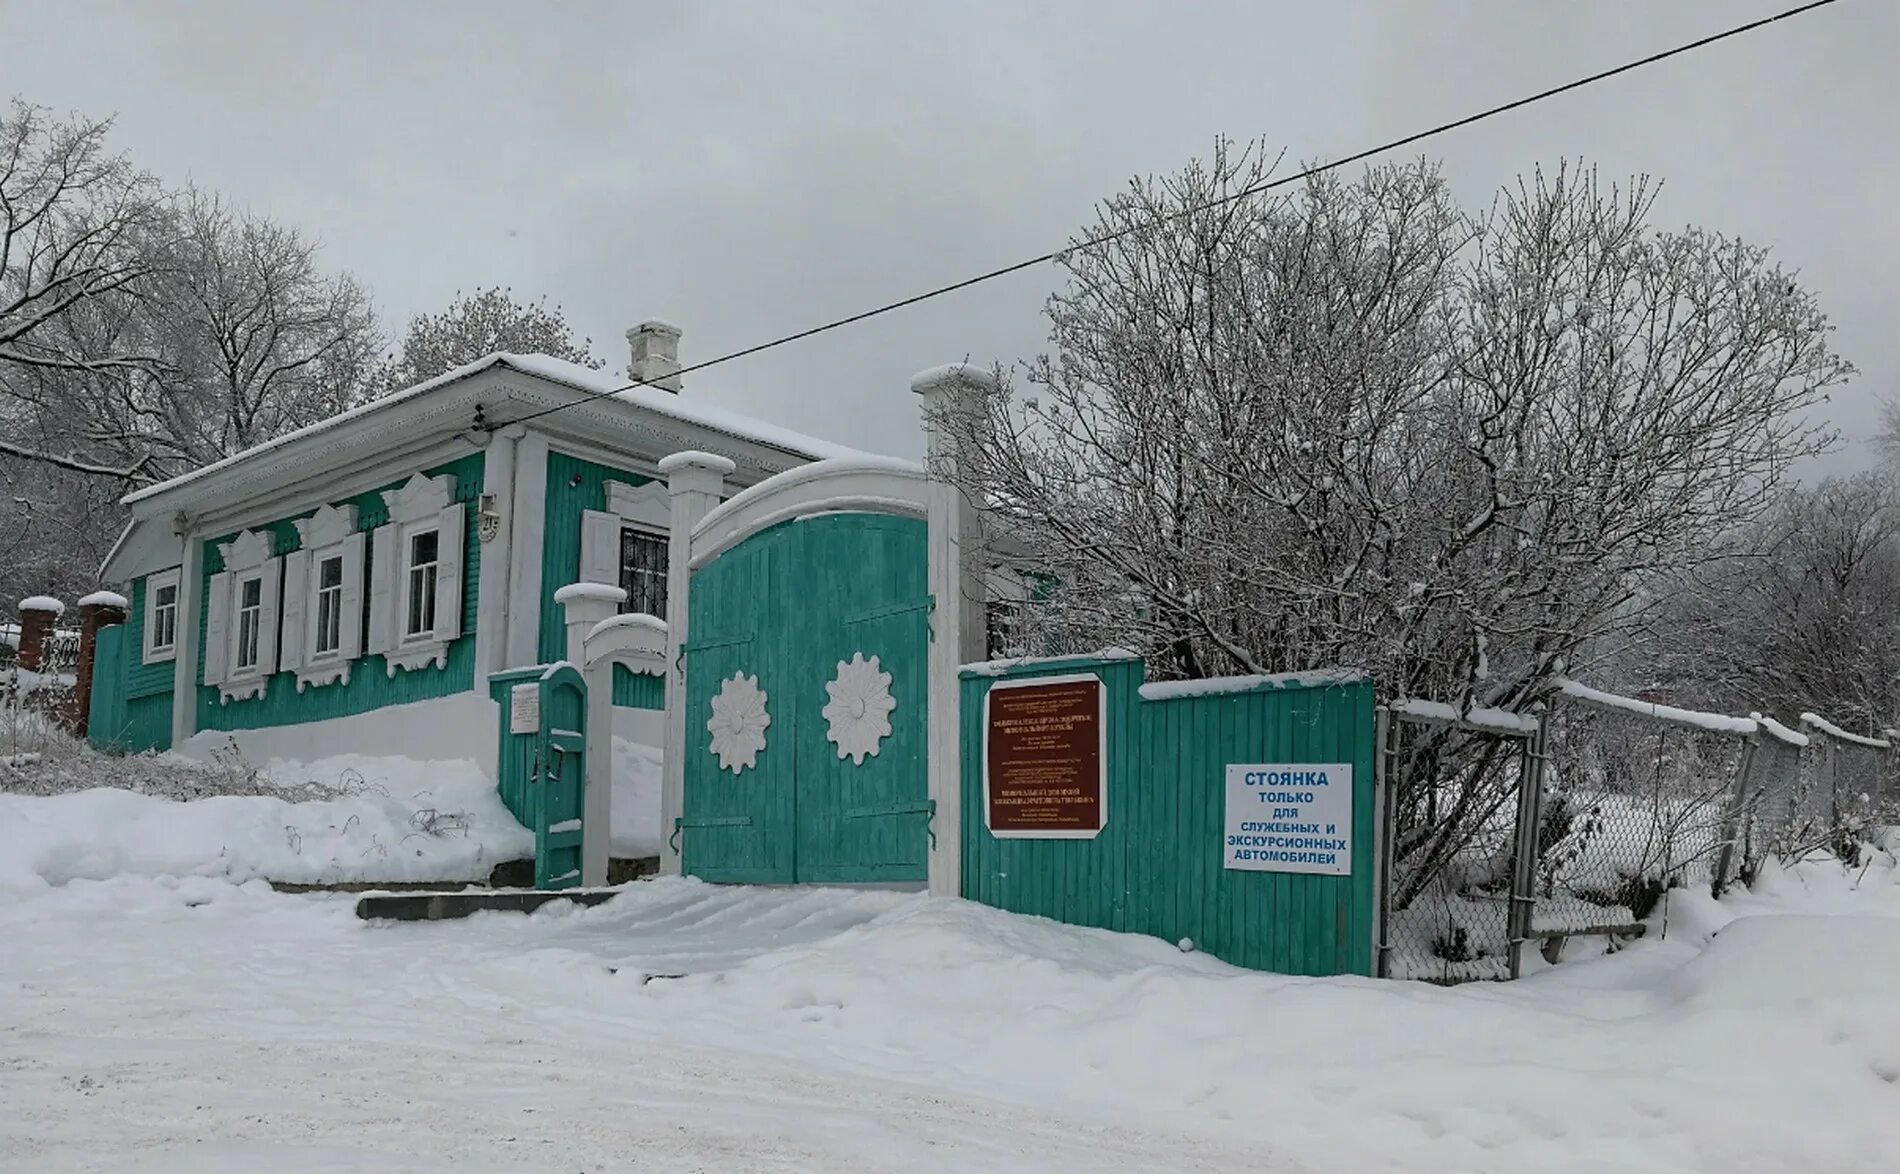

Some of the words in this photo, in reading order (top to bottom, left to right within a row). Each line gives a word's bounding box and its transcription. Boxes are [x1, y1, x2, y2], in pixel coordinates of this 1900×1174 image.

[1245, 771, 1329, 786] СТОЯНКА
[1259, 792, 1314, 803] ТОЛЬКО
[1273, 808, 1299, 820] ДЛЯ
[1241, 822, 1320, 834] СЛУЖЕБНЫХ
[1326, 824, 1336, 835] И
[1227, 835, 1347, 850] ЭКСКУРСИОННЫХ
[1234, 849, 1336, 865] АВТОМОБИЛЕЙ
